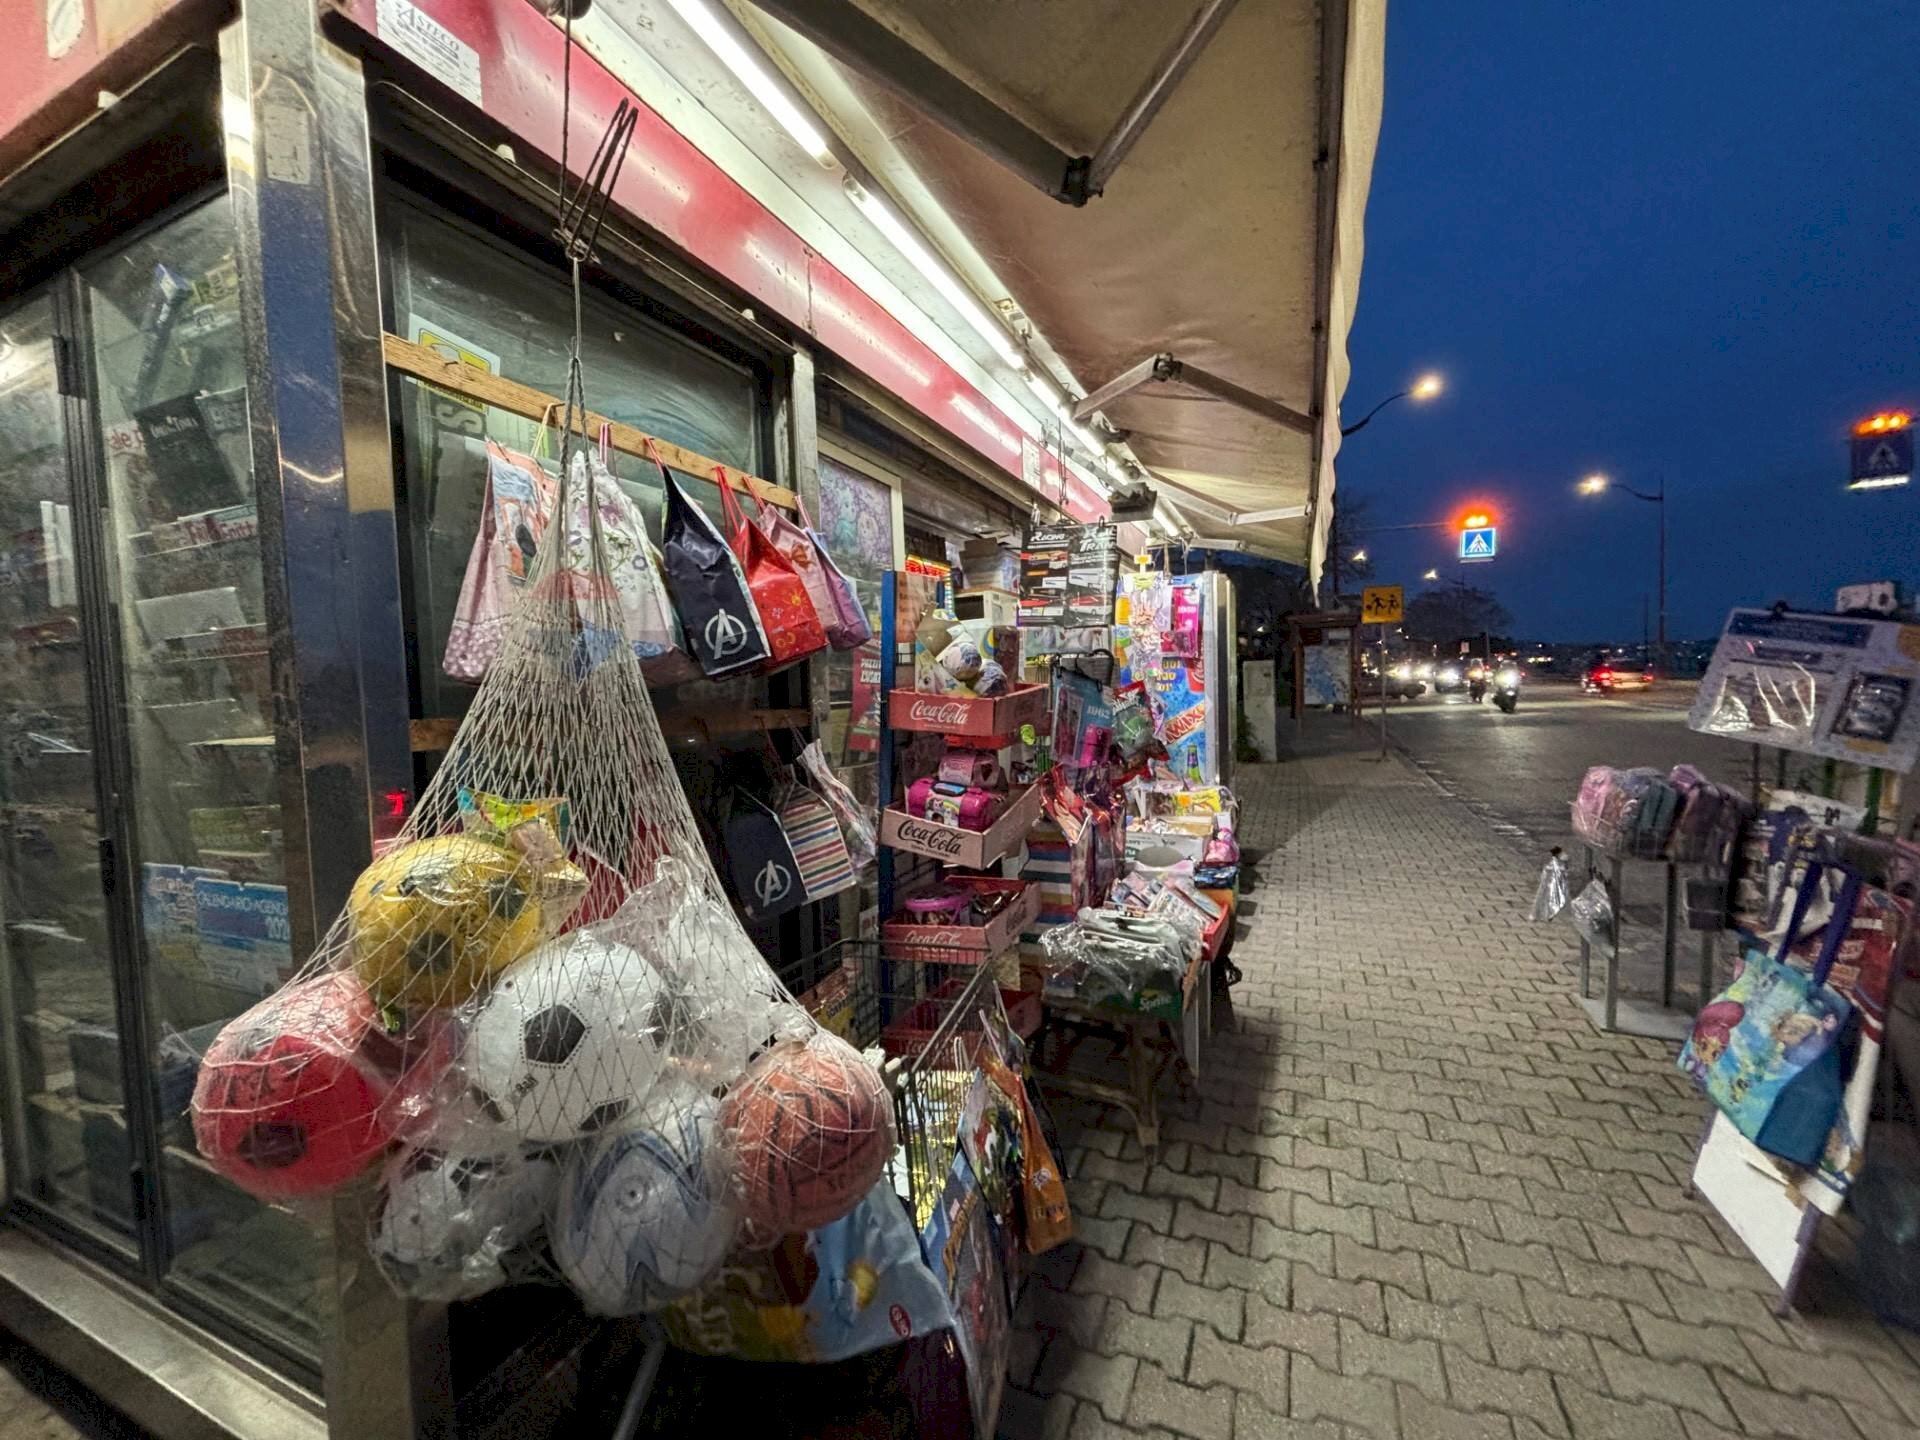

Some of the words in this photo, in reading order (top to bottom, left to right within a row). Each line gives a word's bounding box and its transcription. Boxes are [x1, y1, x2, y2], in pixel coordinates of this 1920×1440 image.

[1029, 532, 1066, 542] RACING
[910, 699, 972, 724] Coca-Cola
[897, 819, 966, 854] Coca-Cola
